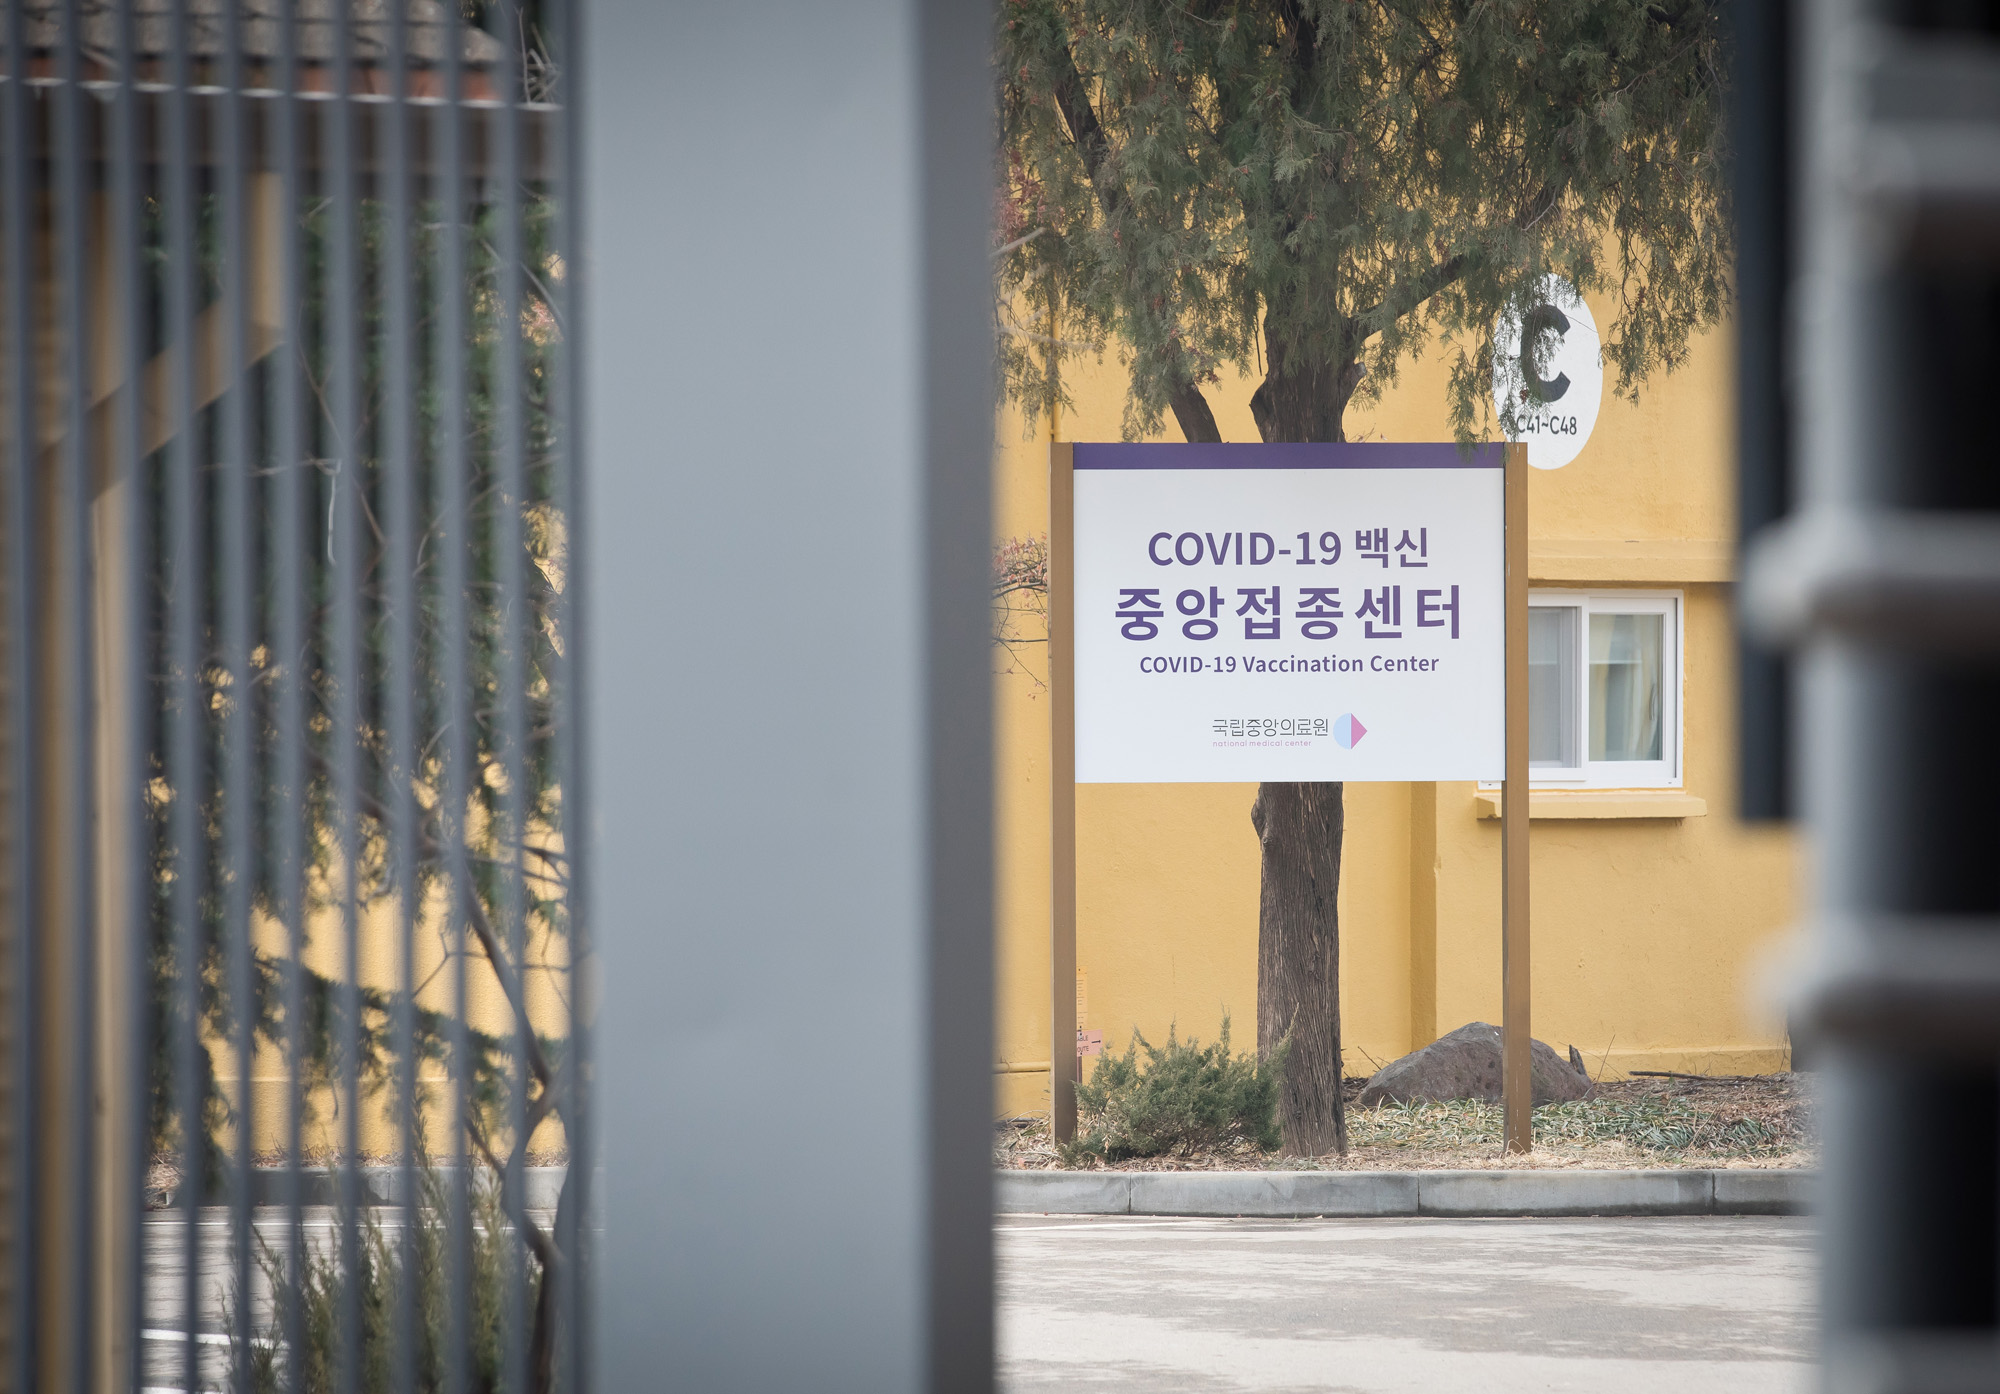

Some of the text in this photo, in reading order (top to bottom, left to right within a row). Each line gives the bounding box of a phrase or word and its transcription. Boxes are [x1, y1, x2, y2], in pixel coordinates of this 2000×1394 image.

[1520, 304, 1571, 403] C
[1516, 414, 1577, 435] C41~C48
[1148, 528, 1429, 568] COVID-19 백신
[1115, 585, 1460, 641] 중앙접종센터
[1140, 654, 1440, 673] COVID-19 Vaccination Center
[1212, 718, 1329, 737] 국립중앙의료원
